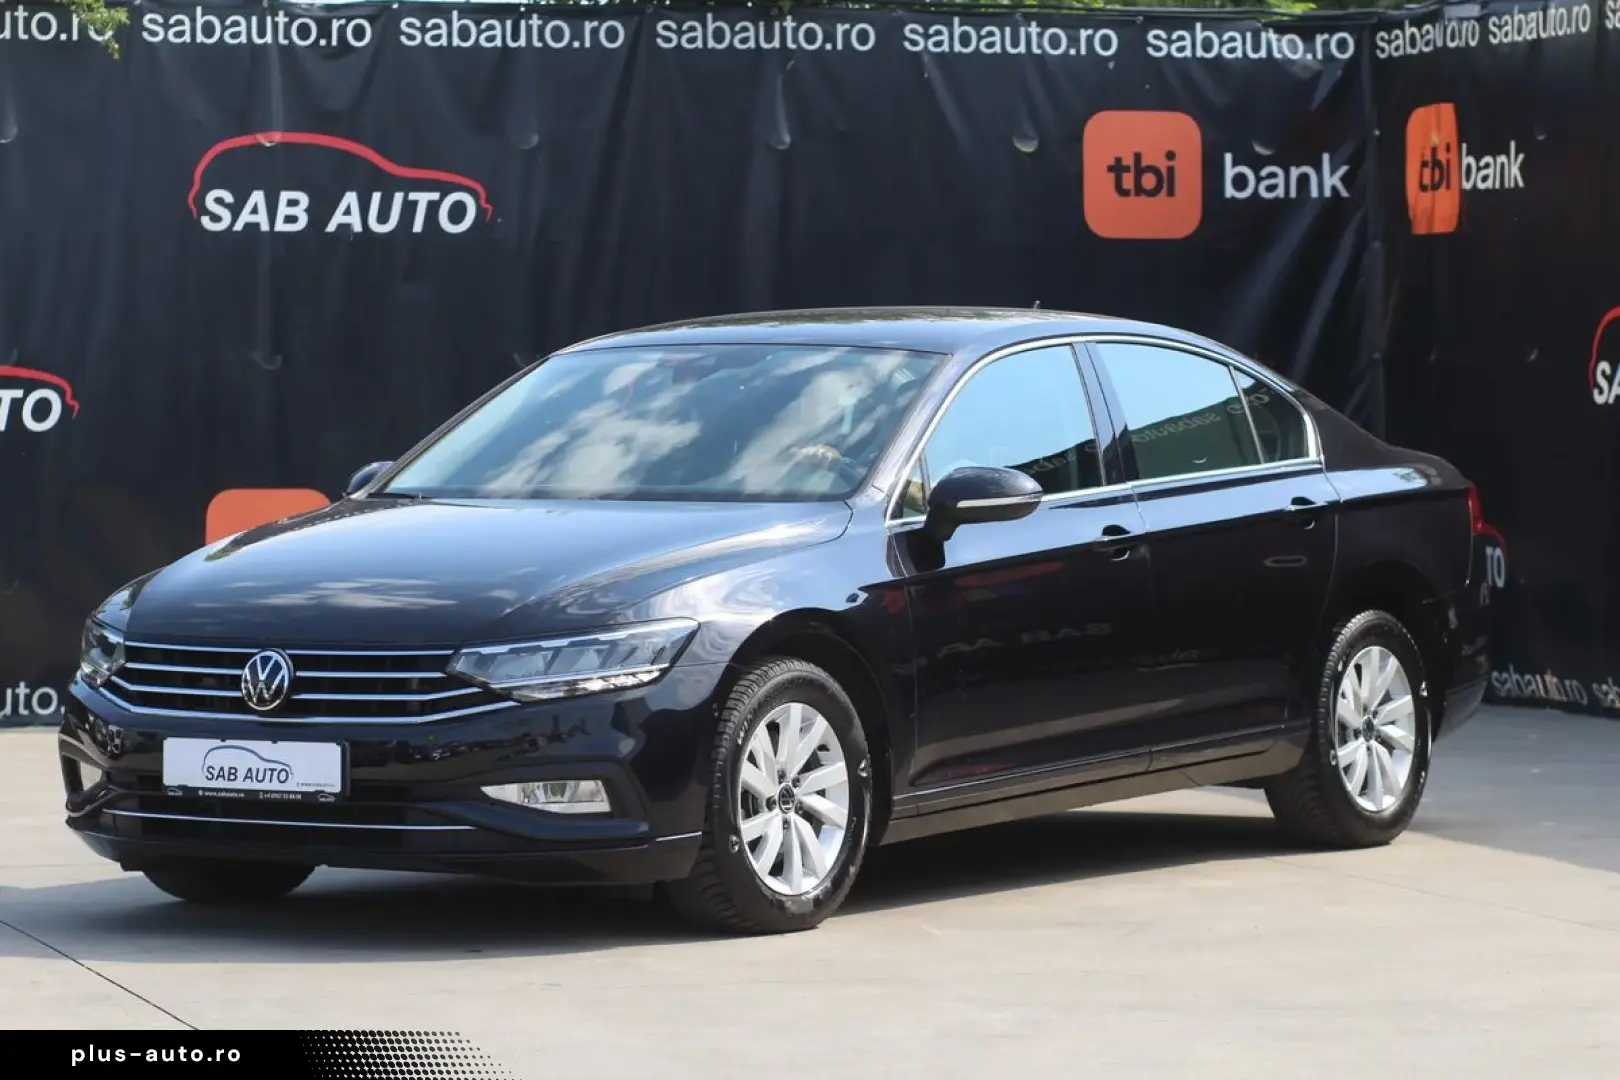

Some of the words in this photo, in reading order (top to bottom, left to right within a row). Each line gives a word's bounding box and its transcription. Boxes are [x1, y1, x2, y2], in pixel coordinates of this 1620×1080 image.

[141, 8, 373, 48] sabauto.ro
[399, 10, 625, 49] sabauto.ro
[655, 14, 876, 52] sabauto.ro
[902, 17, 1119, 57] sabauto.ro
[1146, 23, 1355, 61] sabauto.ro
[1488, 3, 1592, 45] sabauto.ro
[1107, 149, 1177, 198] tbi
[1224, 152, 1349, 199] bank
[1419, 141, 1452, 192] tbi
[1461, 140, 1525, 190] bank
[200, 189, 310, 232] SAB
[325, 191, 477, 234] AUTO
[0, 388, 62, 432] TO
[205, 765, 238, 782] SAB
[242, 767, 290, 784] AUTO
